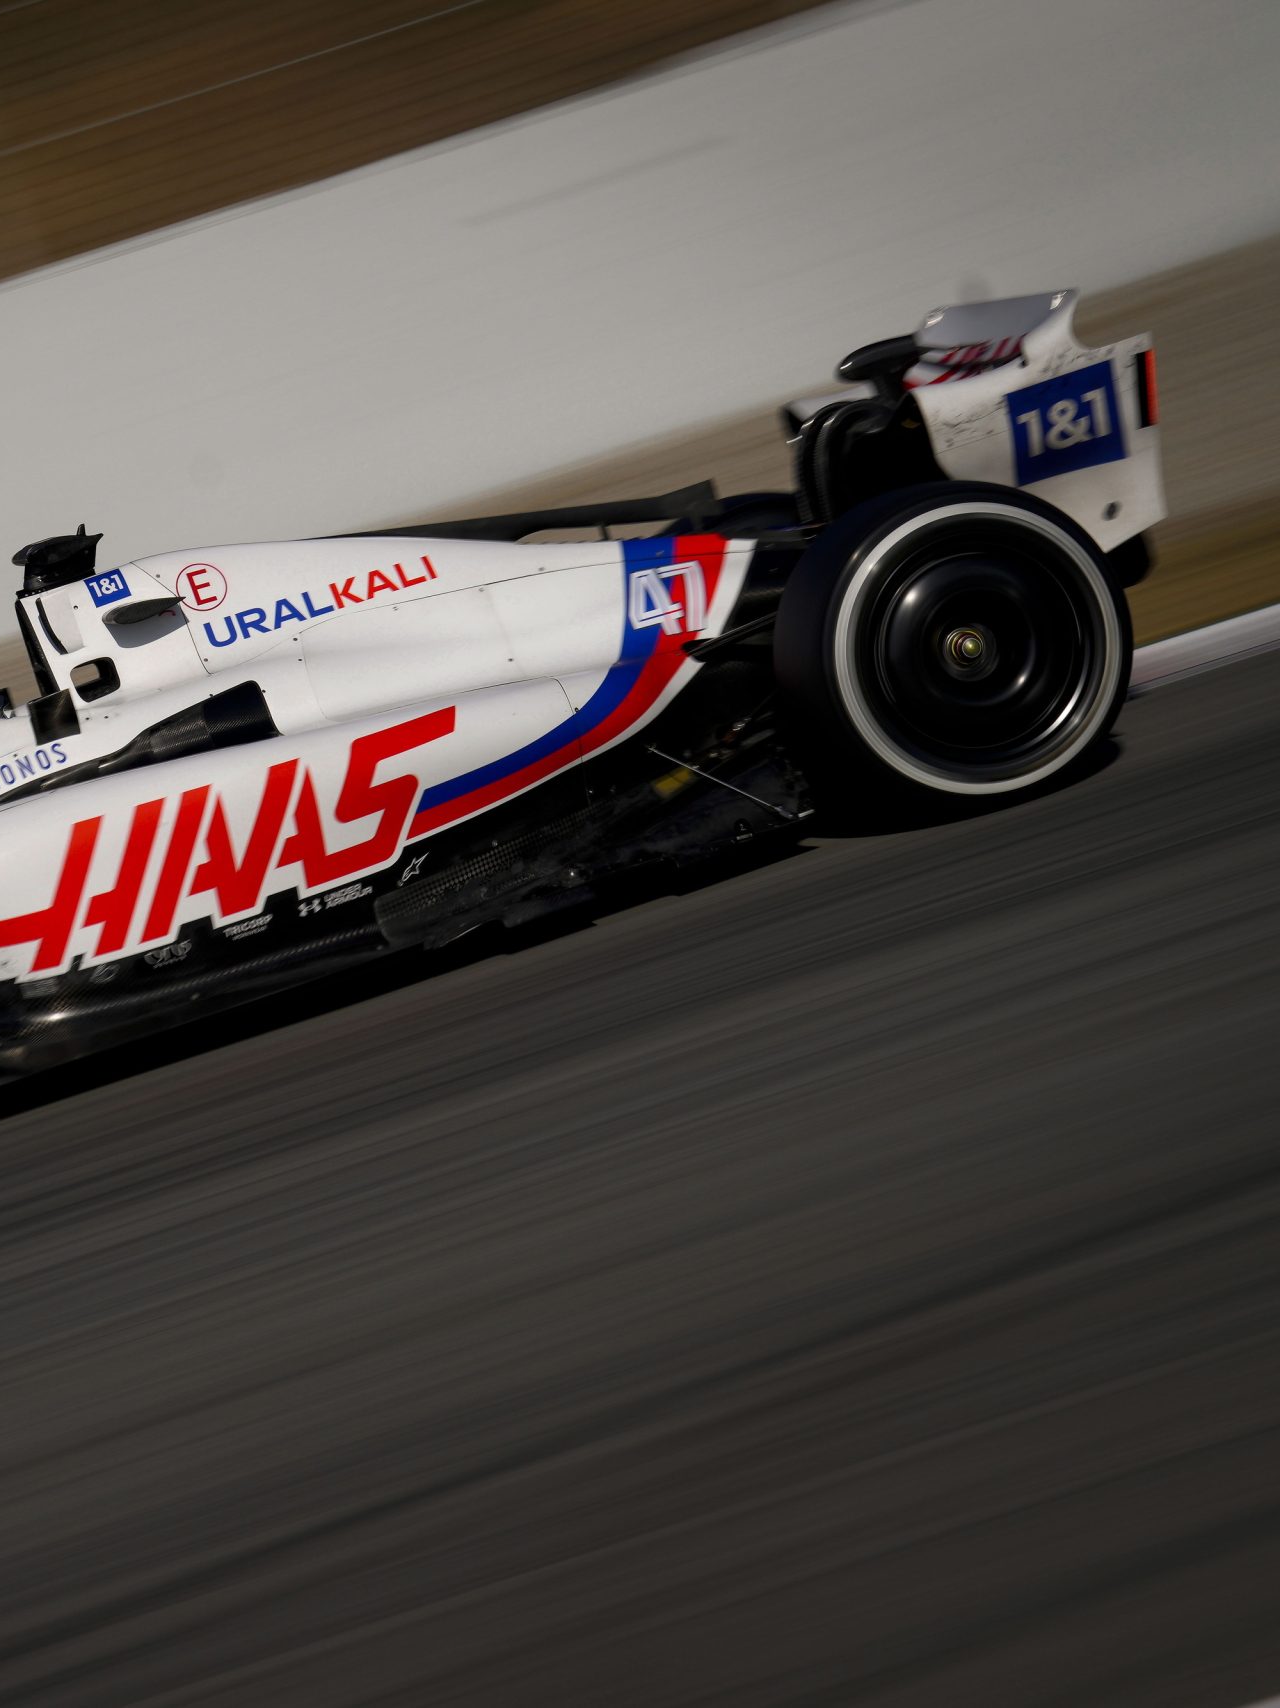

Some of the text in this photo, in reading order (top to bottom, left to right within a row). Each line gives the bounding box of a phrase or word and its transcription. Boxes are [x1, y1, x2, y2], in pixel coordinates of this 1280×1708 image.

[1017, 387, 1112, 458] 1&1
[89, 573, 125, 601] 1&1
[185, 567, 218, 607] E
[203, 555, 439, 648] URALKALI
[629, 560, 709, 635] 47
[325, 886, 373, 909] ARMOUR
